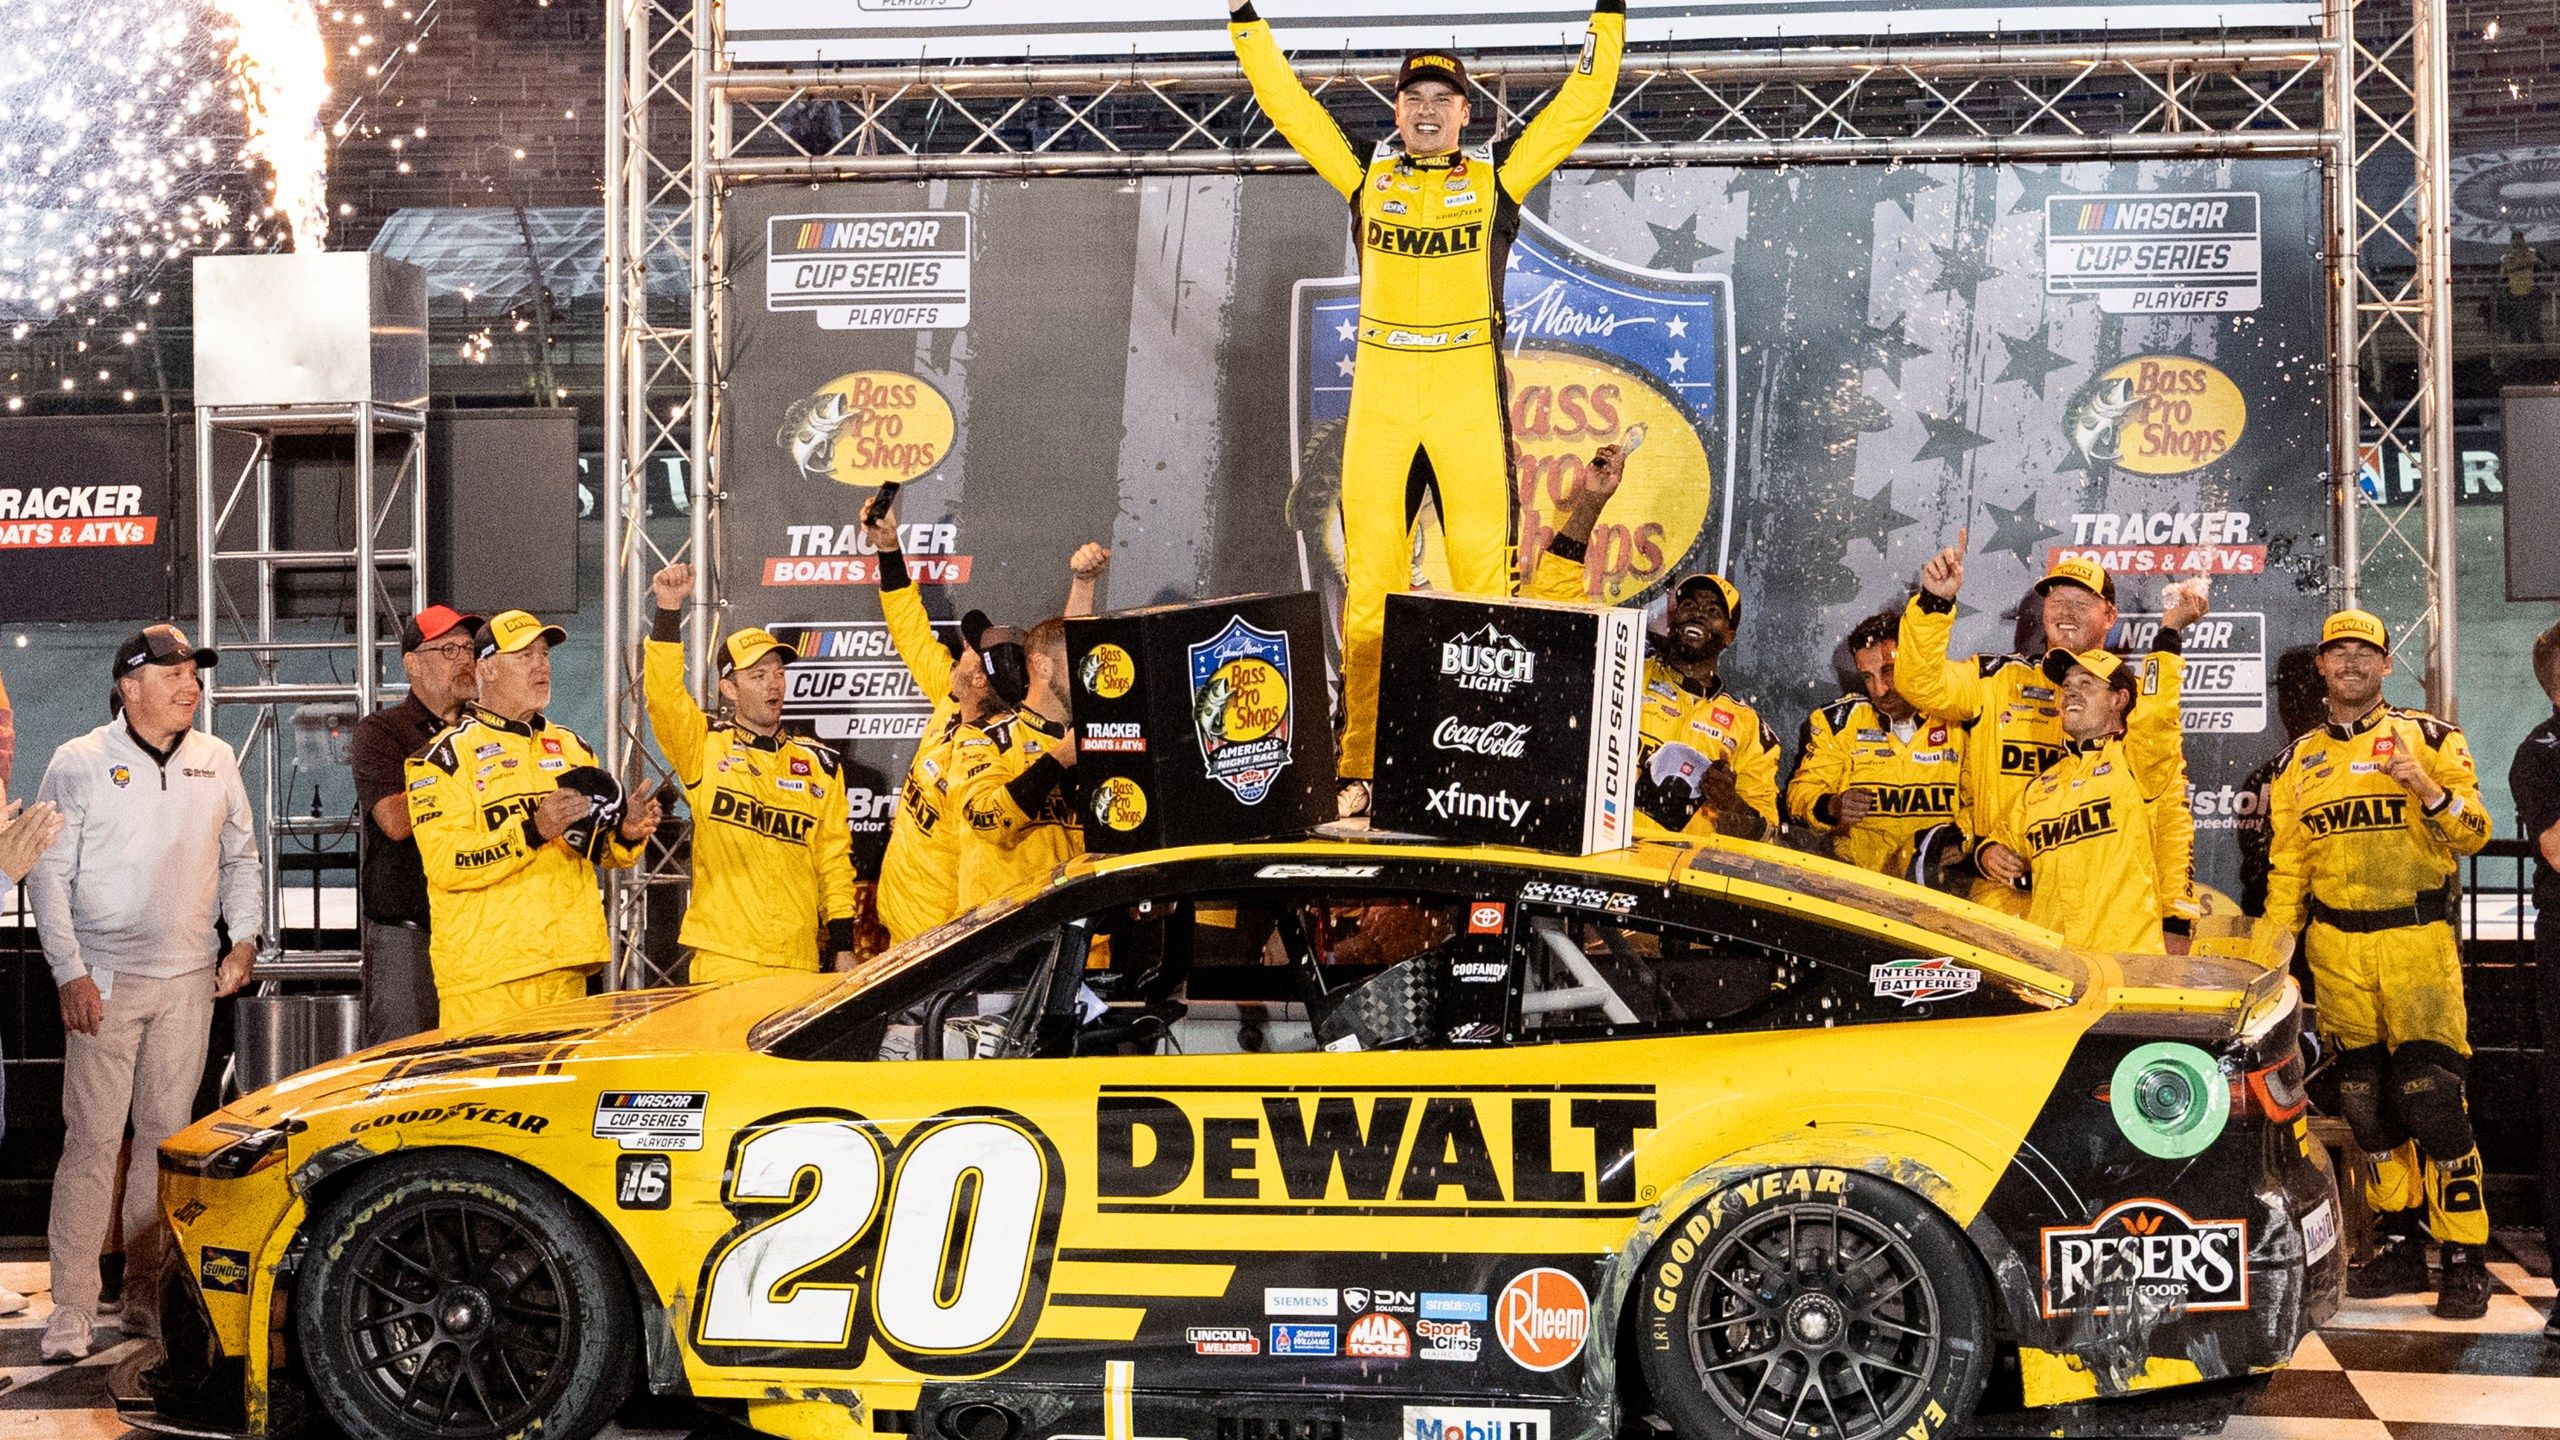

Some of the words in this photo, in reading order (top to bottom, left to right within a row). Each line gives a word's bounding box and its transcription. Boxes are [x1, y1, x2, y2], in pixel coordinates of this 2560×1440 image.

[2114, 201, 2229, 230] NASCAR
[831, 221, 940, 249] NASCAR
[1367, 220, 1482, 254] DEWALT
[2076, 245, 2132, 271] CUP
[2134, 244, 2231, 271] SERIES
[795, 264, 848, 289] CUP
[850, 262, 942, 288] SERIES
[2132, 291, 2229, 309] PLAYOFFS
[847, 308, 939, 325] PLAYOFFS
[2135, 360, 2207, 395] Bass
[850, 376, 917, 409] Bass
[1507, 367, 1624, 442] ass
[2136, 393, 2192, 425] Pro
[851, 407, 903, 438] Pro
[2139, 423, 2227, 465] Shops
[852, 437, 935, 475] Shops
[0, 485, 142, 519] RACKER
[59, 526, 73, 544] &
[77, 522, 145, 544] ATVs
[2071, 512, 2250, 545] TRACKER
[773, 560, 866, 582] BOATS
[908, 560, 960, 581] TVs
[2161, 554, 2176, 571] &
[2118, 621, 2233, 649] NACAR
[1100, 647, 1122, 662] Bass
[1440, 642, 1536, 683] BUSCH
[1102, 661, 1118, 675] Pro
[1231, 665, 1266, 687] Bass
[1610, 621, 1629, 731] SERIES
[793, 672, 846, 697] CUP
[849, 672, 926, 698] SERIE
[1103, 675, 1130, 693] Shops
[1458, 676, 1513, 693] LIGHT
[1232, 686, 1260, 708] Pro
[846, 717, 927, 736] PLAYOFF
[1235, 705, 1279, 731] Shops
[1086, 723, 1141, 738] TRACKER
[1433, 715, 1532, 758] Coca-Cola
[1084, 739, 1113, 751] BOATS
[1121, 739, 1144, 750] ATVs
[1217, 739, 1279, 760] AMERICA'S
[1217, 753, 1251, 769] NIGHT
[1252, 749, 1280, 764] RACE
[1604, 734, 1621, 798] CUP
[1113, 779, 1134, 795] Bass
[1114, 794, 1130, 809] Pro
[1425, 782, 1531, 827] xfinity
[1869, 787, 1955, 813] EWALT
[712, 789, 815, 842] DEWALT
[1115, 808, 1142, 826] Shops
[2193, 816, 2264, 832] peedway
[455, 841, 512, 868] DEWALT
[1875, 968, 1975, 979] INTERSTATE
[1881, 979, 1972, 991] BATTERIES
[632, 1095, 692, 1108] NASCAR
[610, 1113, 639, 1126] CUP
[640, 1114, 689, 1127] SERIES
[637, 1137, 686, 1147] PLAYOFFS
[1097, 1096, 1657, 1203] DEWALT
[625, 1162, 669, 1202] 16
[700, 1118, 1046, 1352] 20
[204, 1262, 247, 1278] SUNOCO
[2058, 1229, 2234, 1304] RESER'S
[1374, 1290, 1416, 1306] DN
[2138, 1283, 2189, 1297] FOODS
[1273, 1297, 1328, 1307] SIEMENS
[1375, 1305, 1415, 1313] SOLUTIONS
[1425, 1298, 1482, 1313] stratasys
[1508, 1273, 1584, 1353] Rheem
[1190, 1330, 1248, 1341] LINCOLN
[1351, 1315, 1408, 1345] MAC
[1418, 1320, 1469, 1338] Sport
[1203, 1343, 1252, 1353] WELDERS
[1351, 1343, 1407, 1356] TOOLS
[1435, 1335, 1479, 1352] Clips
[1416, 1418, 1501, 1440] Mobil
